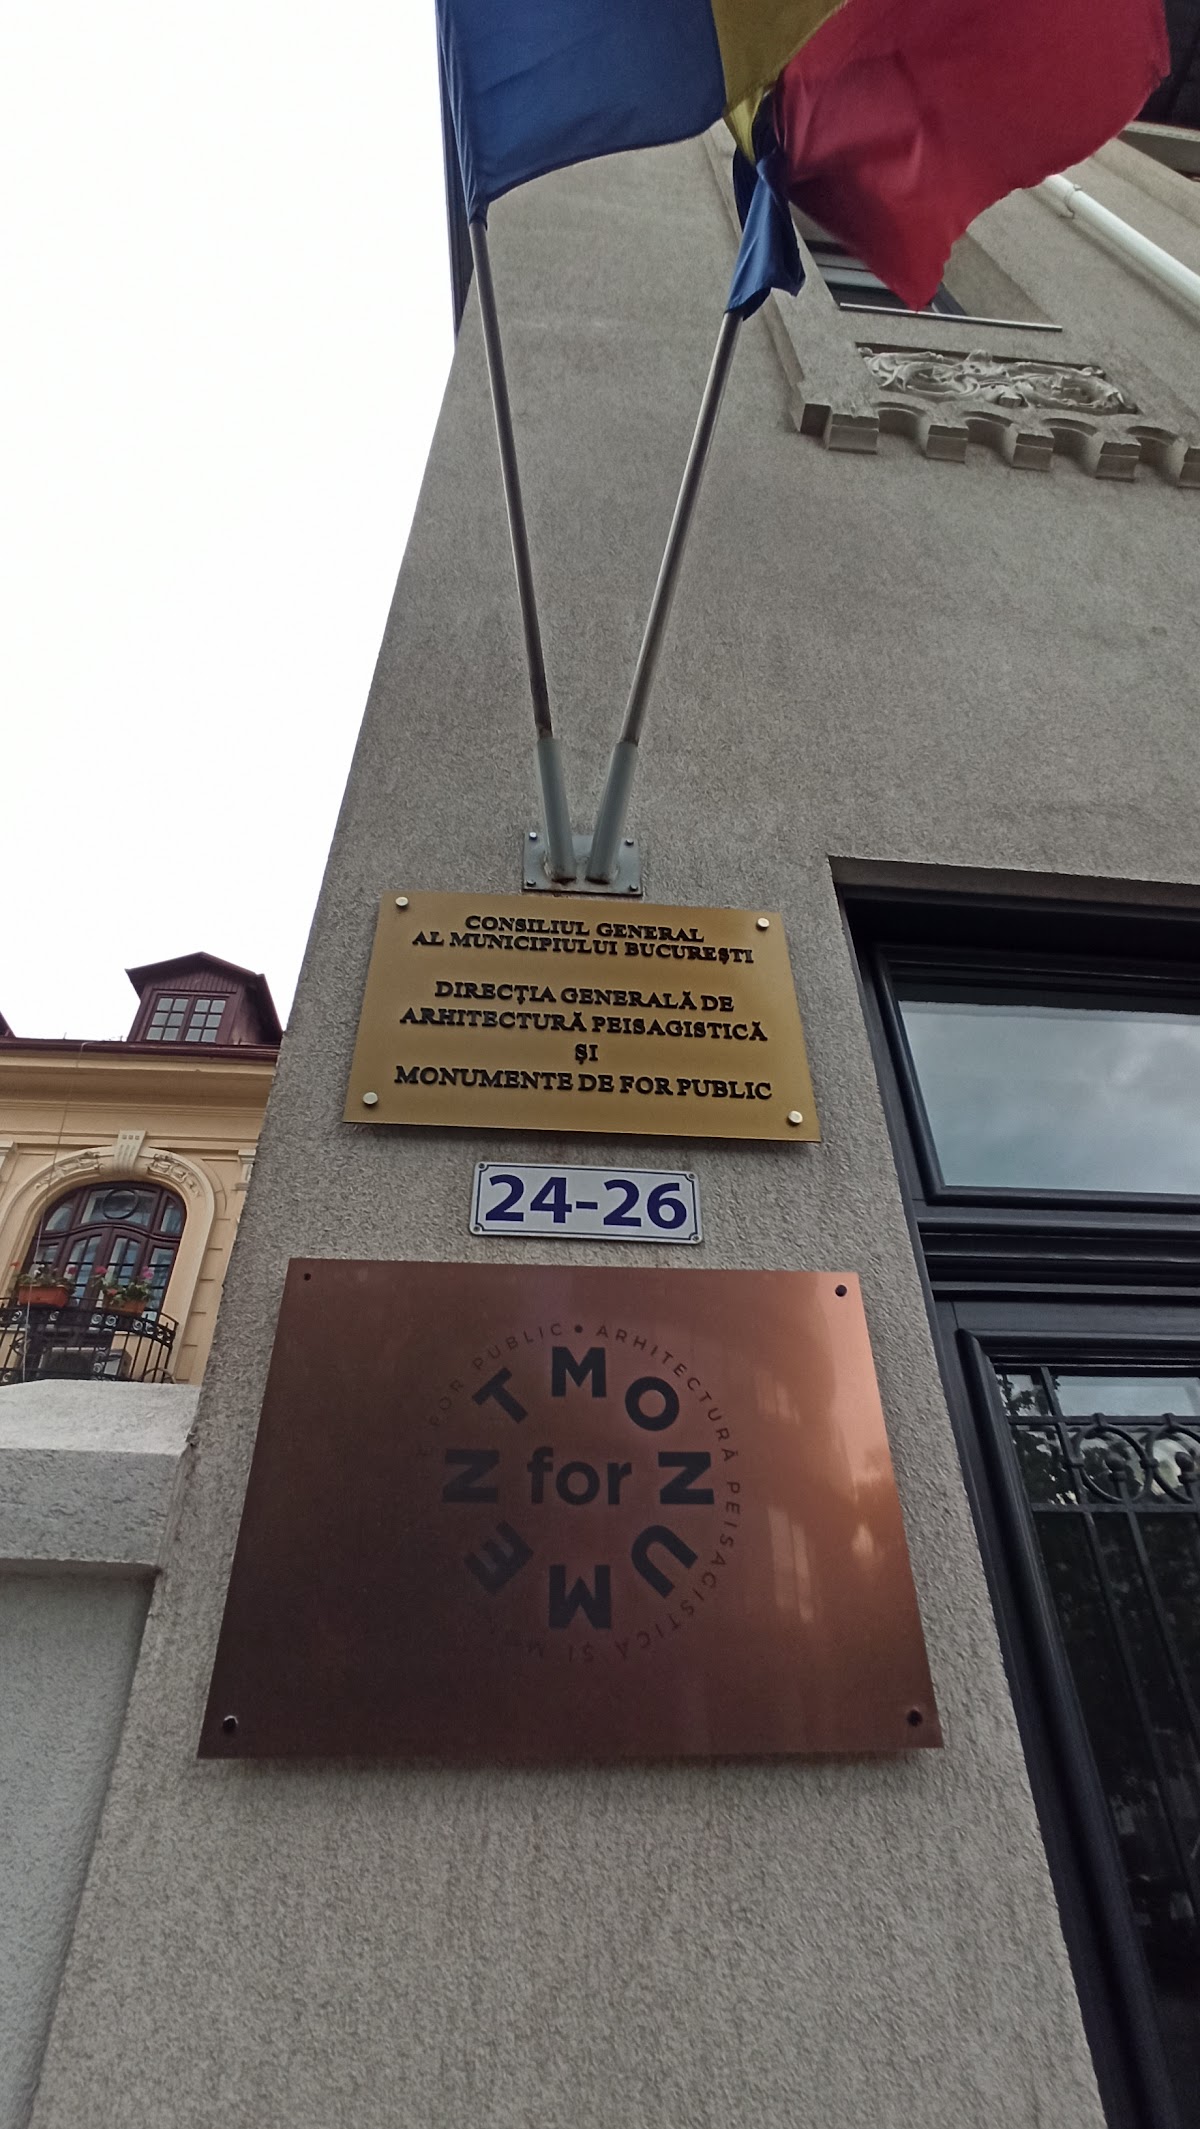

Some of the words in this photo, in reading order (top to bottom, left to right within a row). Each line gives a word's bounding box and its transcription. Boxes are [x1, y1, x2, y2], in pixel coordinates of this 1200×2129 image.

[412, 931, 444, 947] AL
[449, 932, 618, 956] MUNICIPIULUI
[465, 915, 590, 935] CONSILIUL
[597, 922, 704, 943] GENERAL
[560, 986, 697, 1011] GENERALĂ
[701, 995, 734, 1013] DE
[400, 1007, 586, 1032] ARHITECTURĂ
[592, 1014, 768, 1042] PEISAGISTICĂ
[395, 1066, 573, 1091] MONUMENTE
[578, 1073, 615, 1094] DE
[620, 1076, 674, 1096] FOR
[678, 1079, 773, 1100] PUBLIC
[485, 1174, 687, 1230] 24-26
[472, 1322, 563, 1371] PUBLIC
[527, 1446, 632, 1506] for
